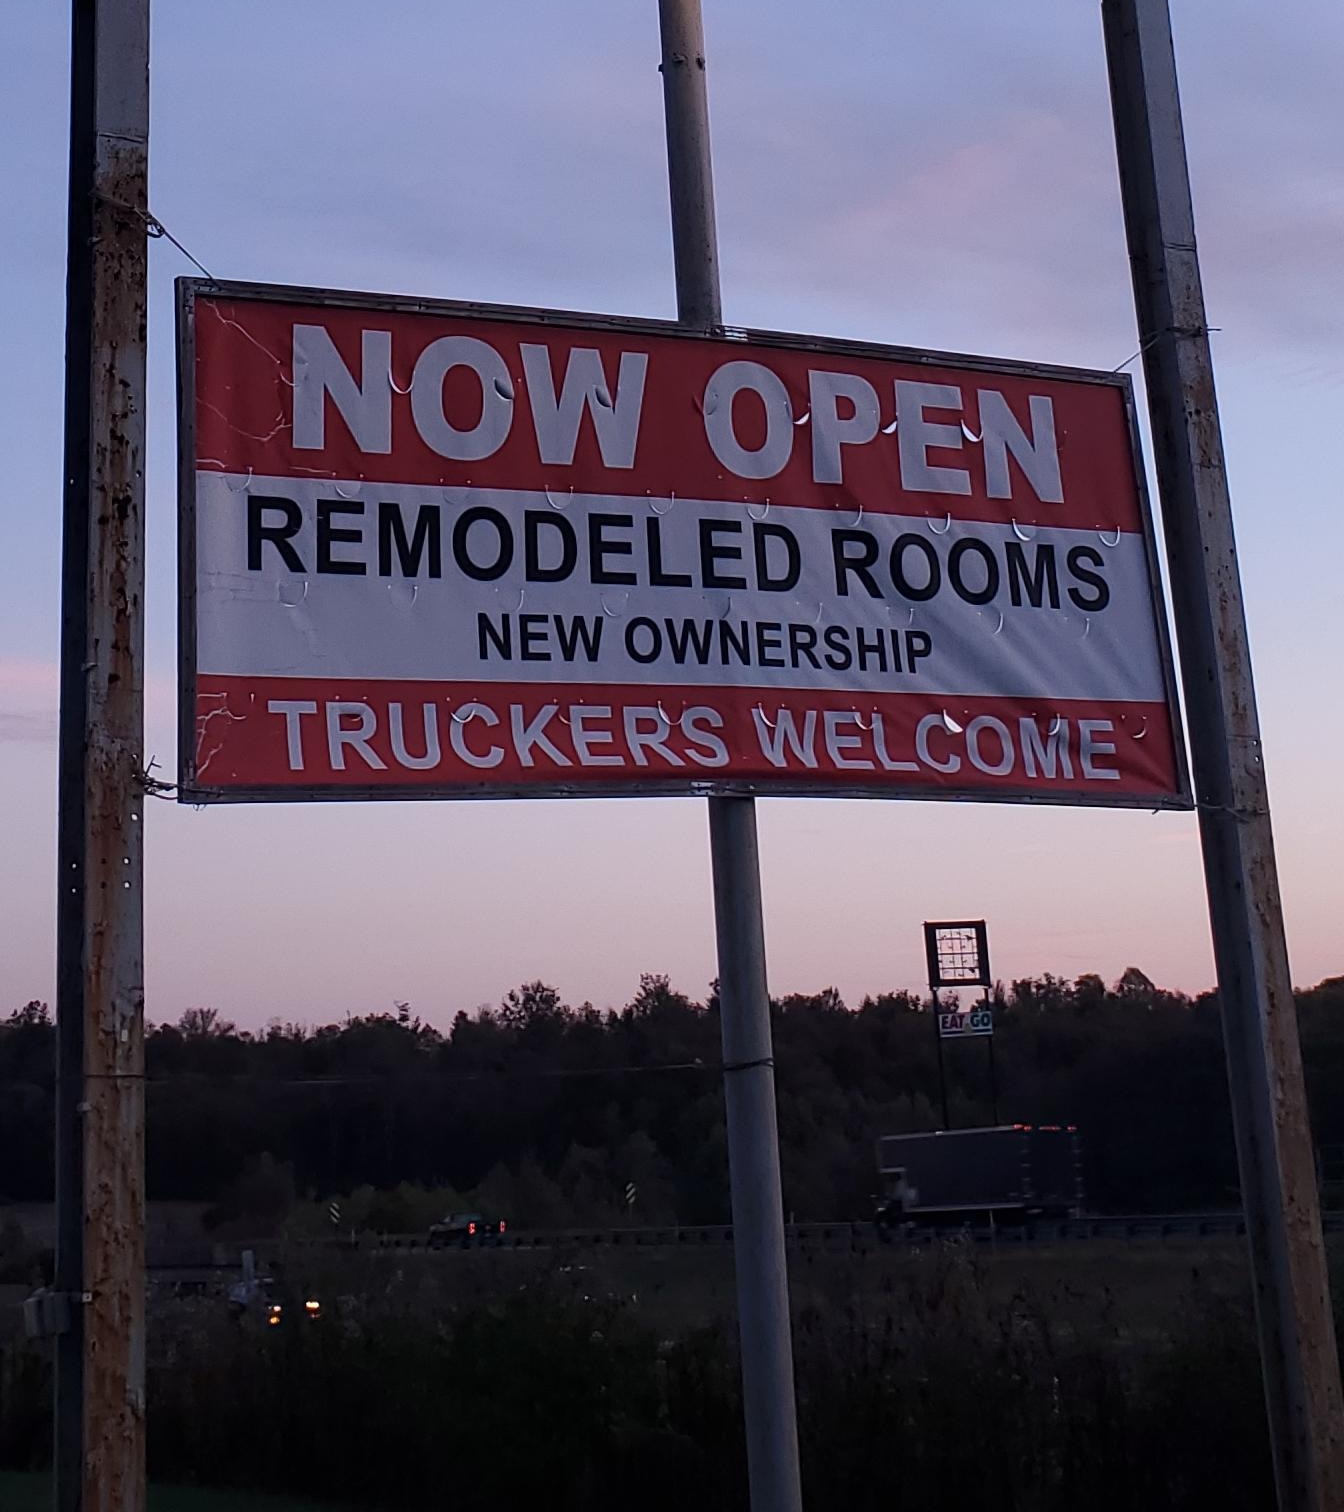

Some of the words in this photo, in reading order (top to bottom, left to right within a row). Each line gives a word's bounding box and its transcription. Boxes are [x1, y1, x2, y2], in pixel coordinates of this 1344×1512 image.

[292, 323, 648, 470] NOW
[703, 360, 1064, 504] OPEN
[247, 495, 801, 594] REMODELED
[831, 528, 1110, 612] ROOMS
[477, 612, 603, 662] NEW
[624, 616, 932, 674] OWNERSHIP
[267, 700, 730, 770] TRUCKERS
[751, 707, 1120, 780] WELCOME
[941, 1014, 965, 1029] EAT
[970, 1013, 990, 1027] GO
